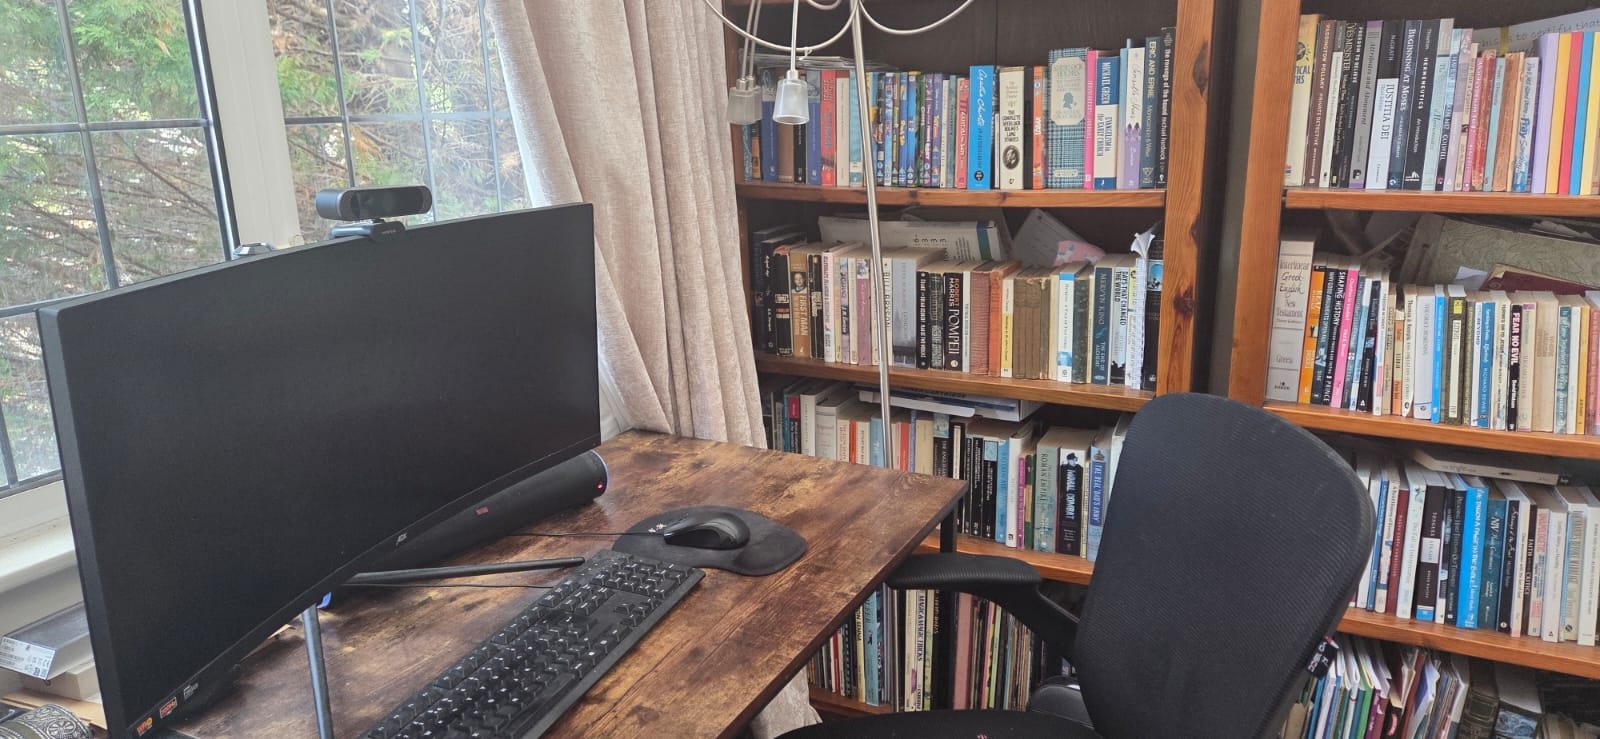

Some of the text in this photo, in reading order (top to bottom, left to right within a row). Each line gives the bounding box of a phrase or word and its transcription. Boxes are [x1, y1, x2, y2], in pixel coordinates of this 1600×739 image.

[1148, 41, 1156, 58] ERIC
[1344, 39, 1353, 71] MINISTER
[1148, 59, 1156, 75] AND
[1162, 60, 1170, 81] revenge
[1400, 28, 1416, 111] BEGINNING AT MOSES
[1101, 62, 1111, 104] MICHAEL GREEN
[1365, 79, 1374, 89] and
[1418, 58, 1429, 109] HERMENEUTICS
[1382, 84, 1395, 122] IUSTITIA
[1380, 124, 1390, 140] DEI
[1440, 134, 1449, 160] COLWELL
[1282, 271, 1302, 281] Greek
[1336, 272, 1346, 299] SHAPING
[1280, 284, 1304, 298] English
[1286, 299, 1296, 308] New
[1333, 300, 1342, 325] HISTORY
[948, 309, 960, 354] POMPEII
[1512, 312, 1520, 333] FEAR
[1511, 335, 1520, 347] NO
[1511, 348, 1519, 365] EVIL
[1039, 453, 1049, 501] ROMAN EMPIRE
[1094, 477, 1102, 488] REAL
[1064, 469, 1076, 520] MORAL COMBAT
[1490, 517, 1500, 531] NIV
